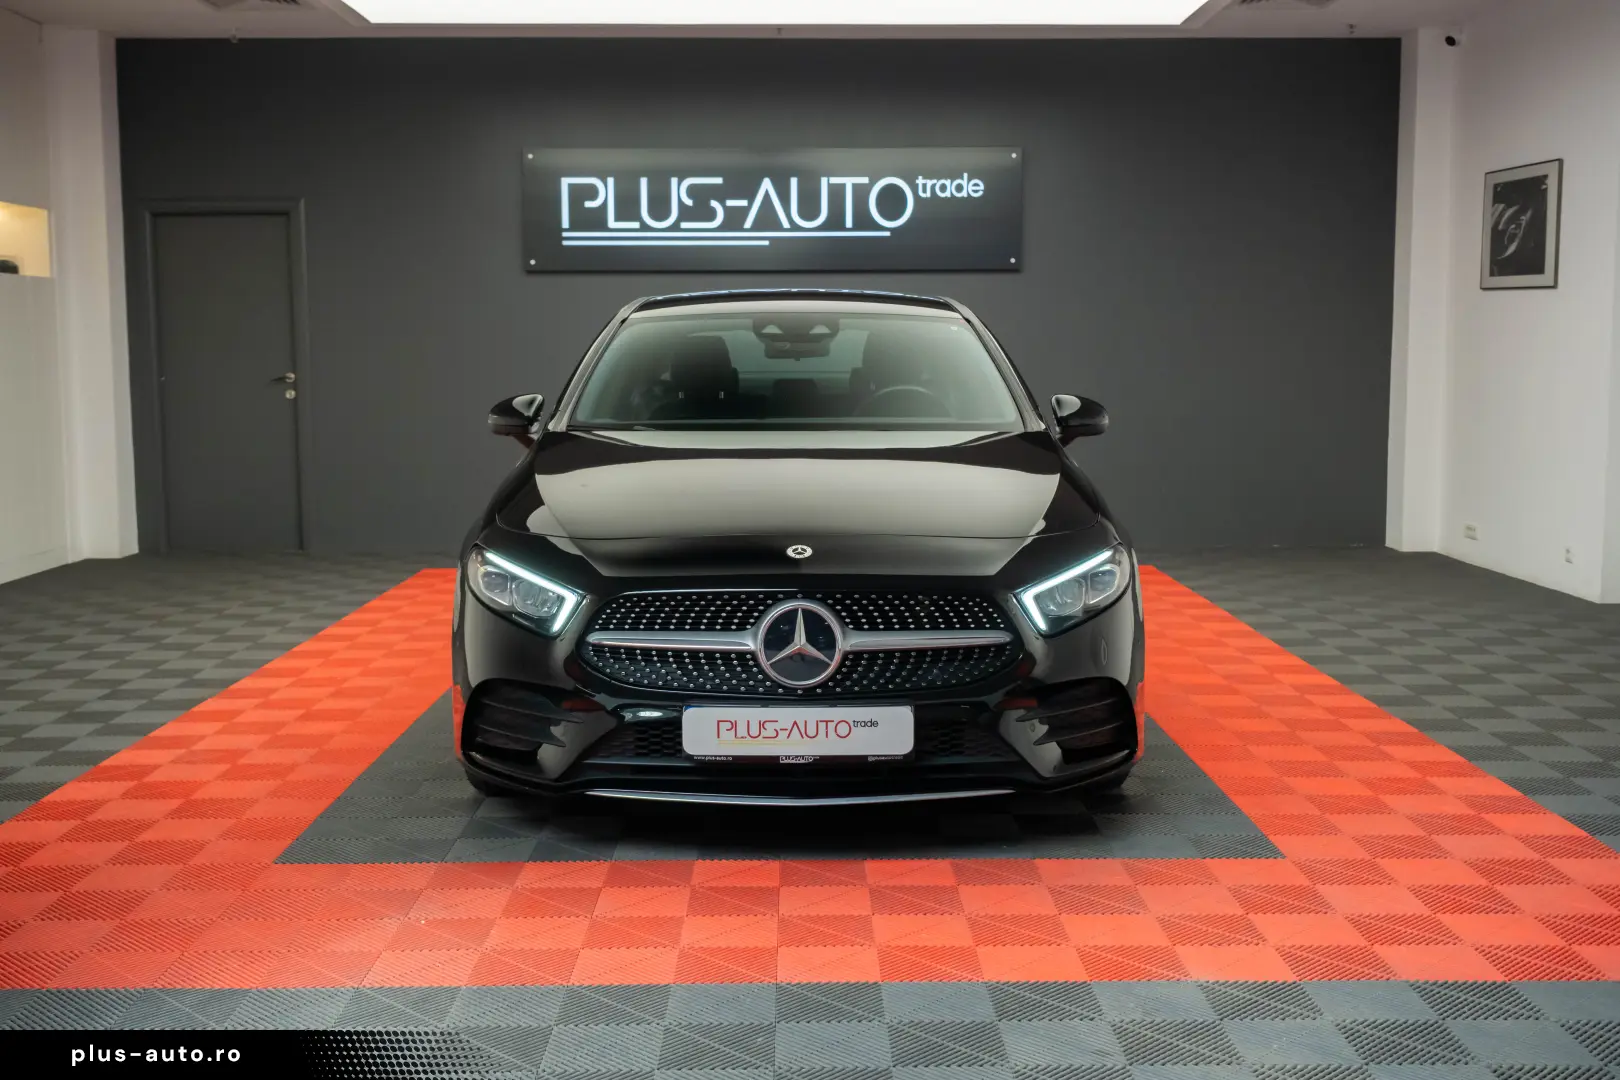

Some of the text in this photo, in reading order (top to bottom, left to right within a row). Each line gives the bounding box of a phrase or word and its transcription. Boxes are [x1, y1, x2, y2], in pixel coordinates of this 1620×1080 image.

[560, 172, 985, 229] PLUS-AUTO trade
[716, 718, 879, 740] PLUS-AUTO trade
